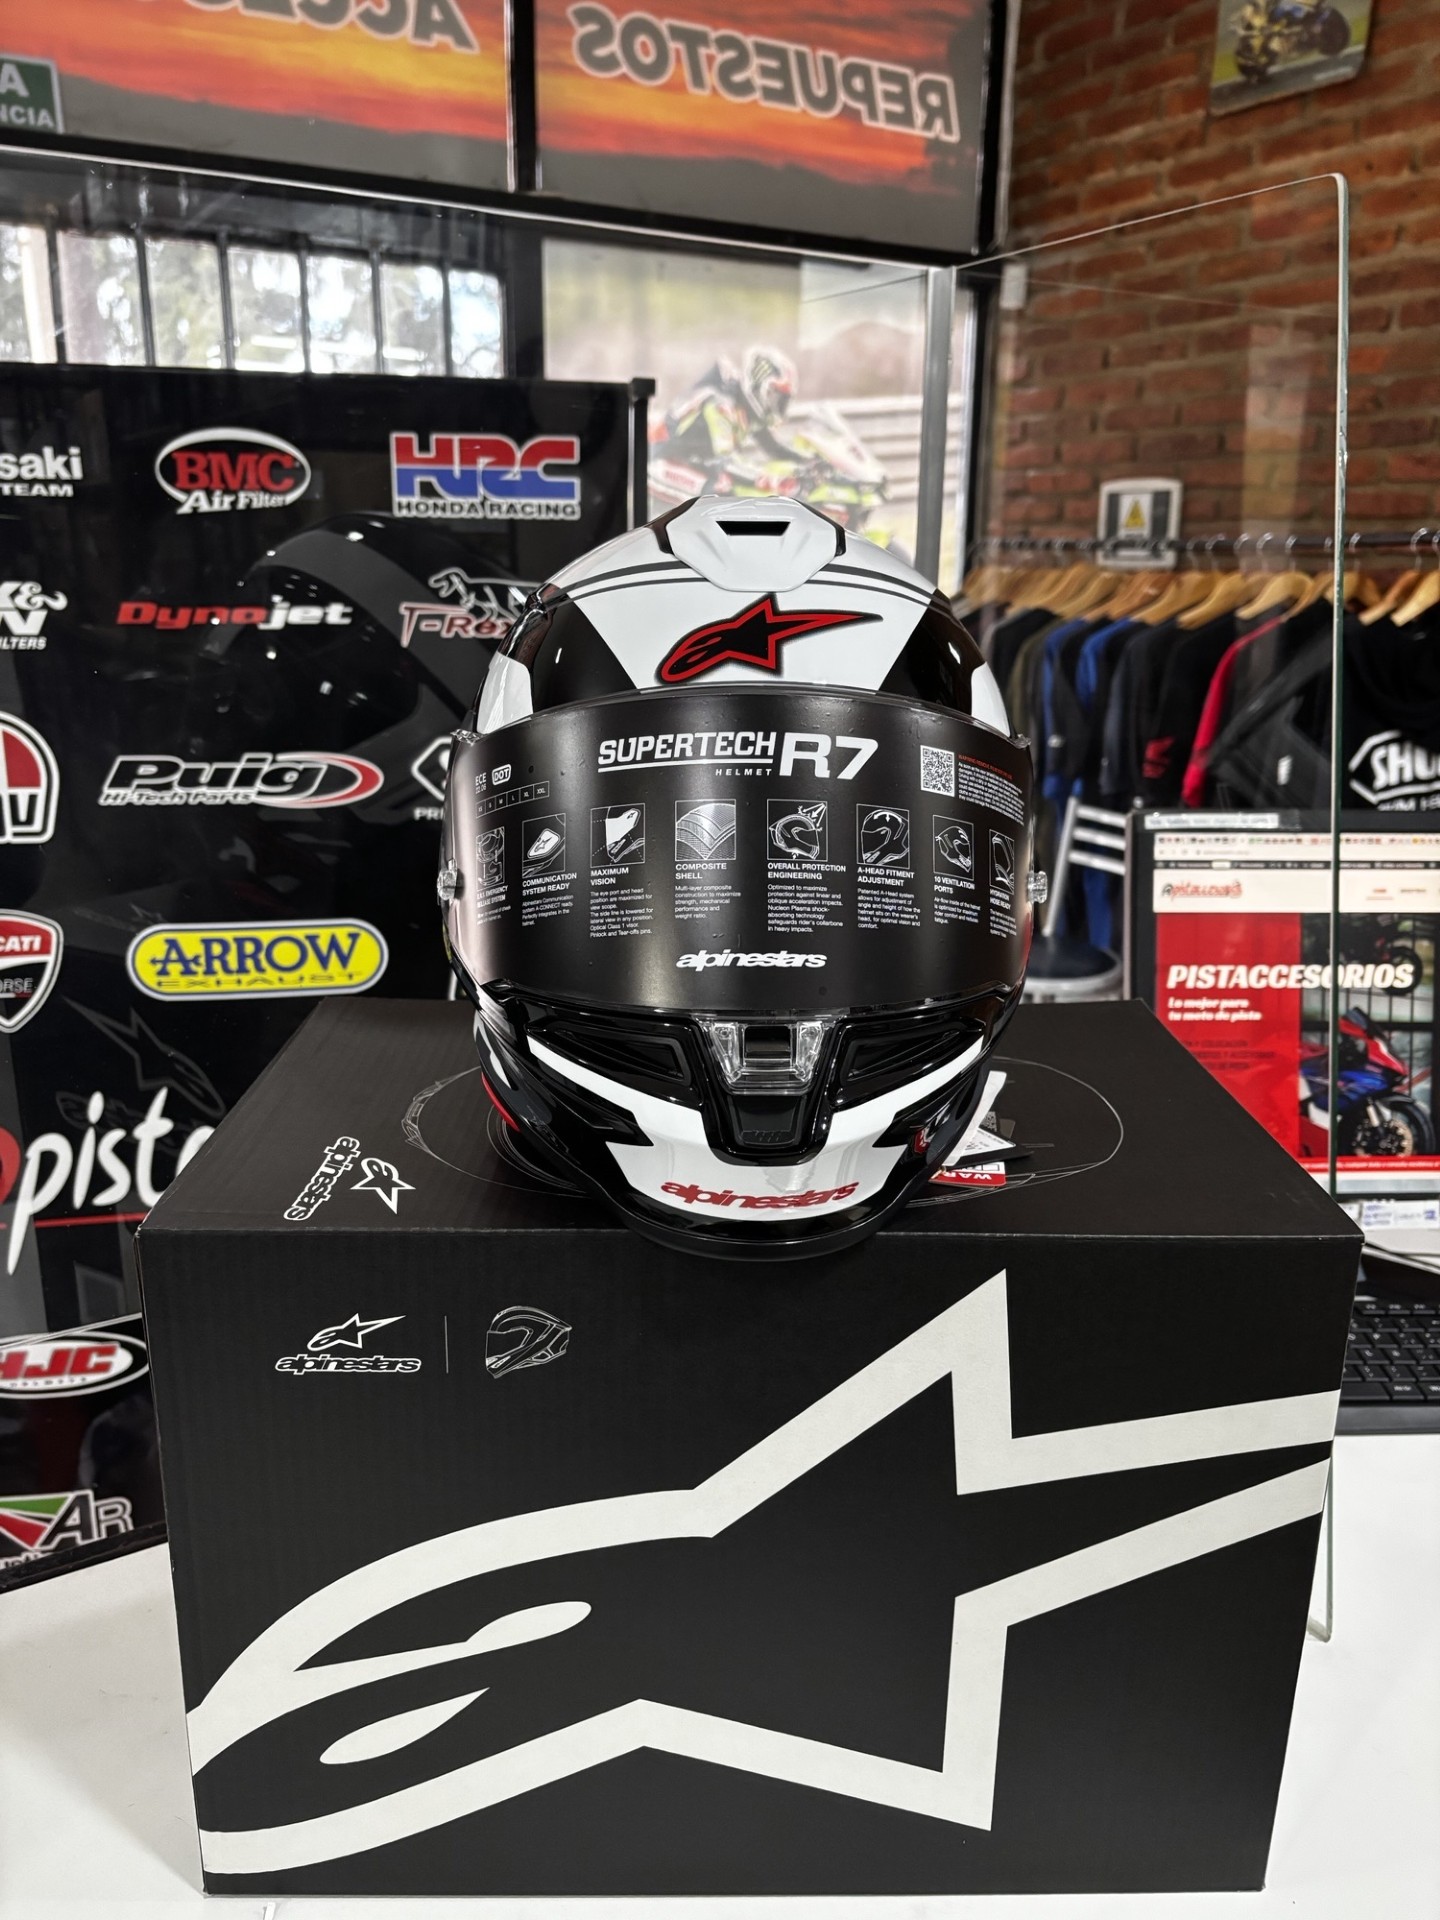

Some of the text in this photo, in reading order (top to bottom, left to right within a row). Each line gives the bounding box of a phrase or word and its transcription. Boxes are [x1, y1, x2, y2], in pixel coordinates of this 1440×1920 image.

[171, 450, 295, 492] BMC
[390, 432, 580, 502] HRC
[0, 483, 74, 497] TEAM
[176, 489, 288, 515] Air Filter
[396, 500, 580, 520] HONDA RACING
[116, 594, 354, 630] Dynojet
[598, 732, 878, 780] SUPERTECH R7
[103, 752, 328, 801] Puig
[475, 772, 486, 786] ECE
[494, 768, 509, 781] DOT
[715, 768, 772, 776] HELMET
[591, 867, 629, 877] MAXIMUM
[802, 863, 846, 872] PROTECTION
[857, 867, 915, 878] A-HEAD FITMENT
[522, 872, 577, 888] COMMUNICATION
[590, 877, 616, 886] VISION
[857, 876, 904, 886] ADJUSTMENT
[942, 877, 975, 890] VENTILATION
[522, 883, 570, 896] SYSTEM READY
[934, 885, 953, 894] PORTS
[149, 932, 362, 977] ARROW
[675, 949, 828, 972] alpinestars
[156, 968, 364, 989] EXHAUST
[283, 1136, 361, 1221] alpinestars
[660, 1180, 860, 1209] alpinestars
[275, 1354, 422, 1376] alpinestars
